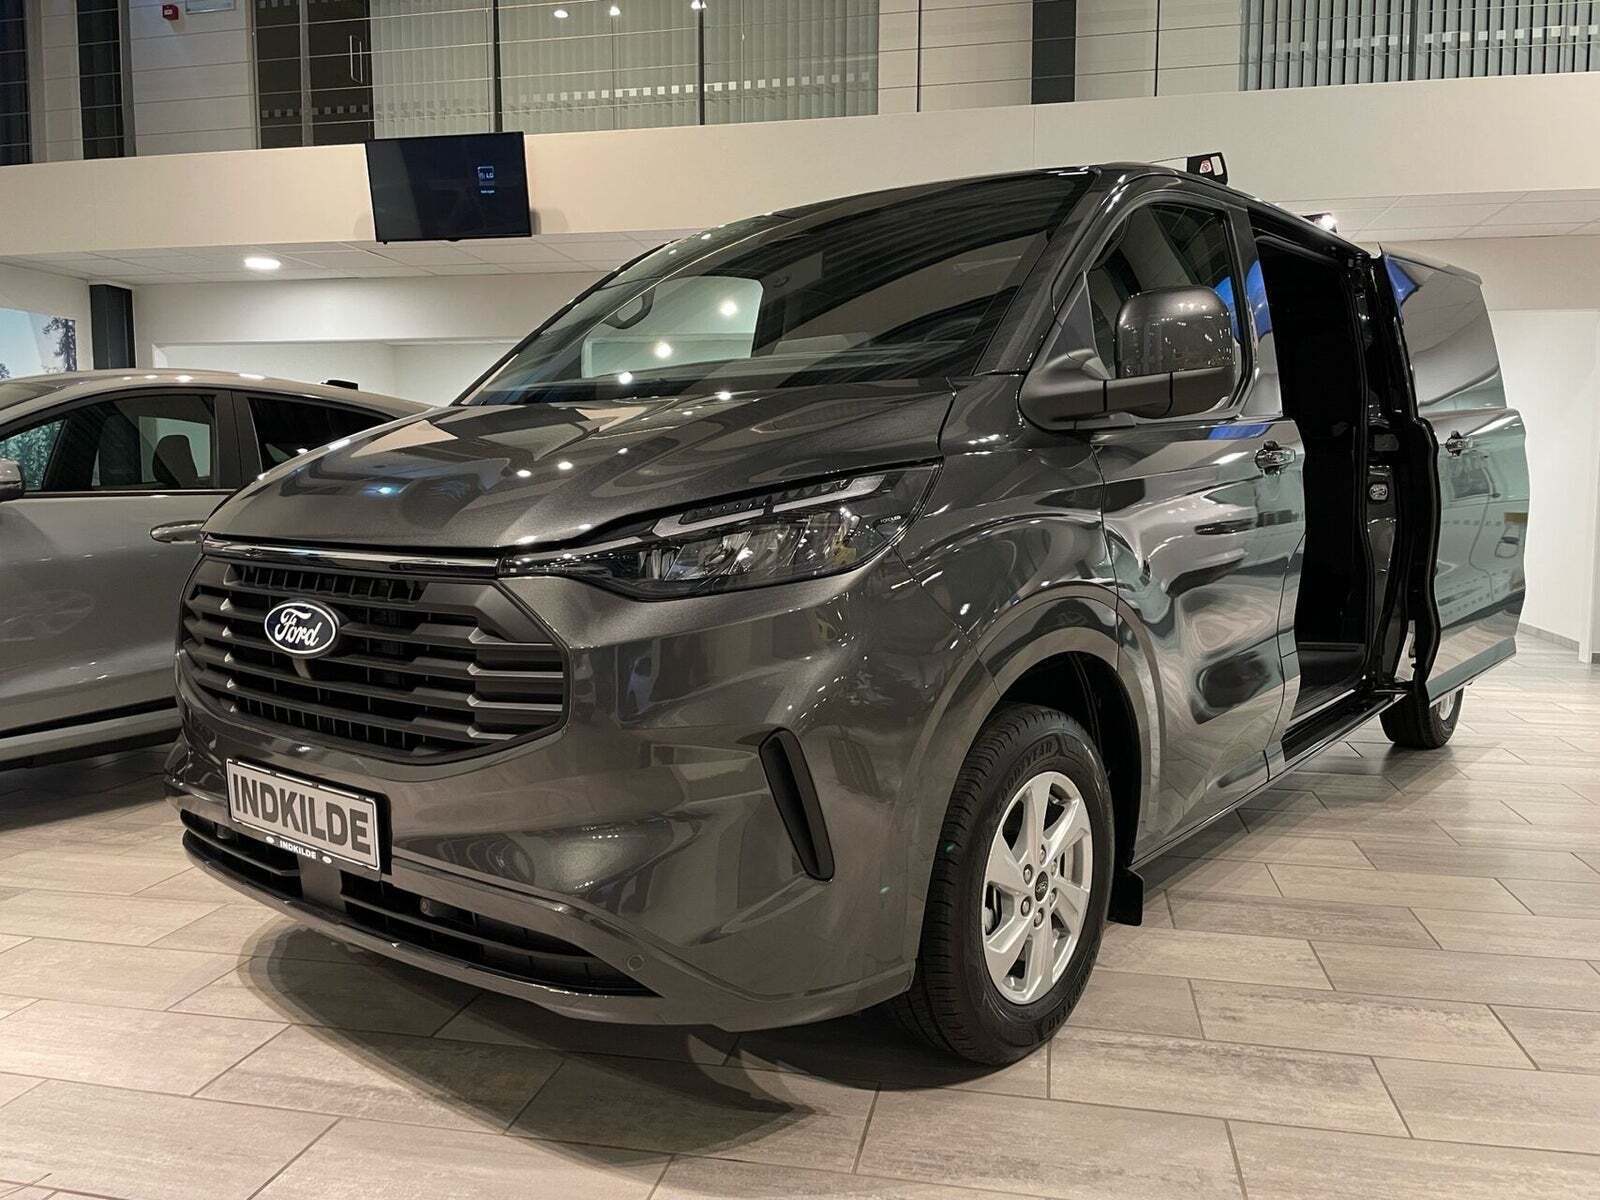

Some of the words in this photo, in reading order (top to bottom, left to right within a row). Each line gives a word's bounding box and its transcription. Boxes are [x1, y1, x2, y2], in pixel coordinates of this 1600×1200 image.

[274, 608, 322, 646] Ford
[233, 773, 371, 855] INDKILDE
[279, 840, 317, 860] INDKILDE
